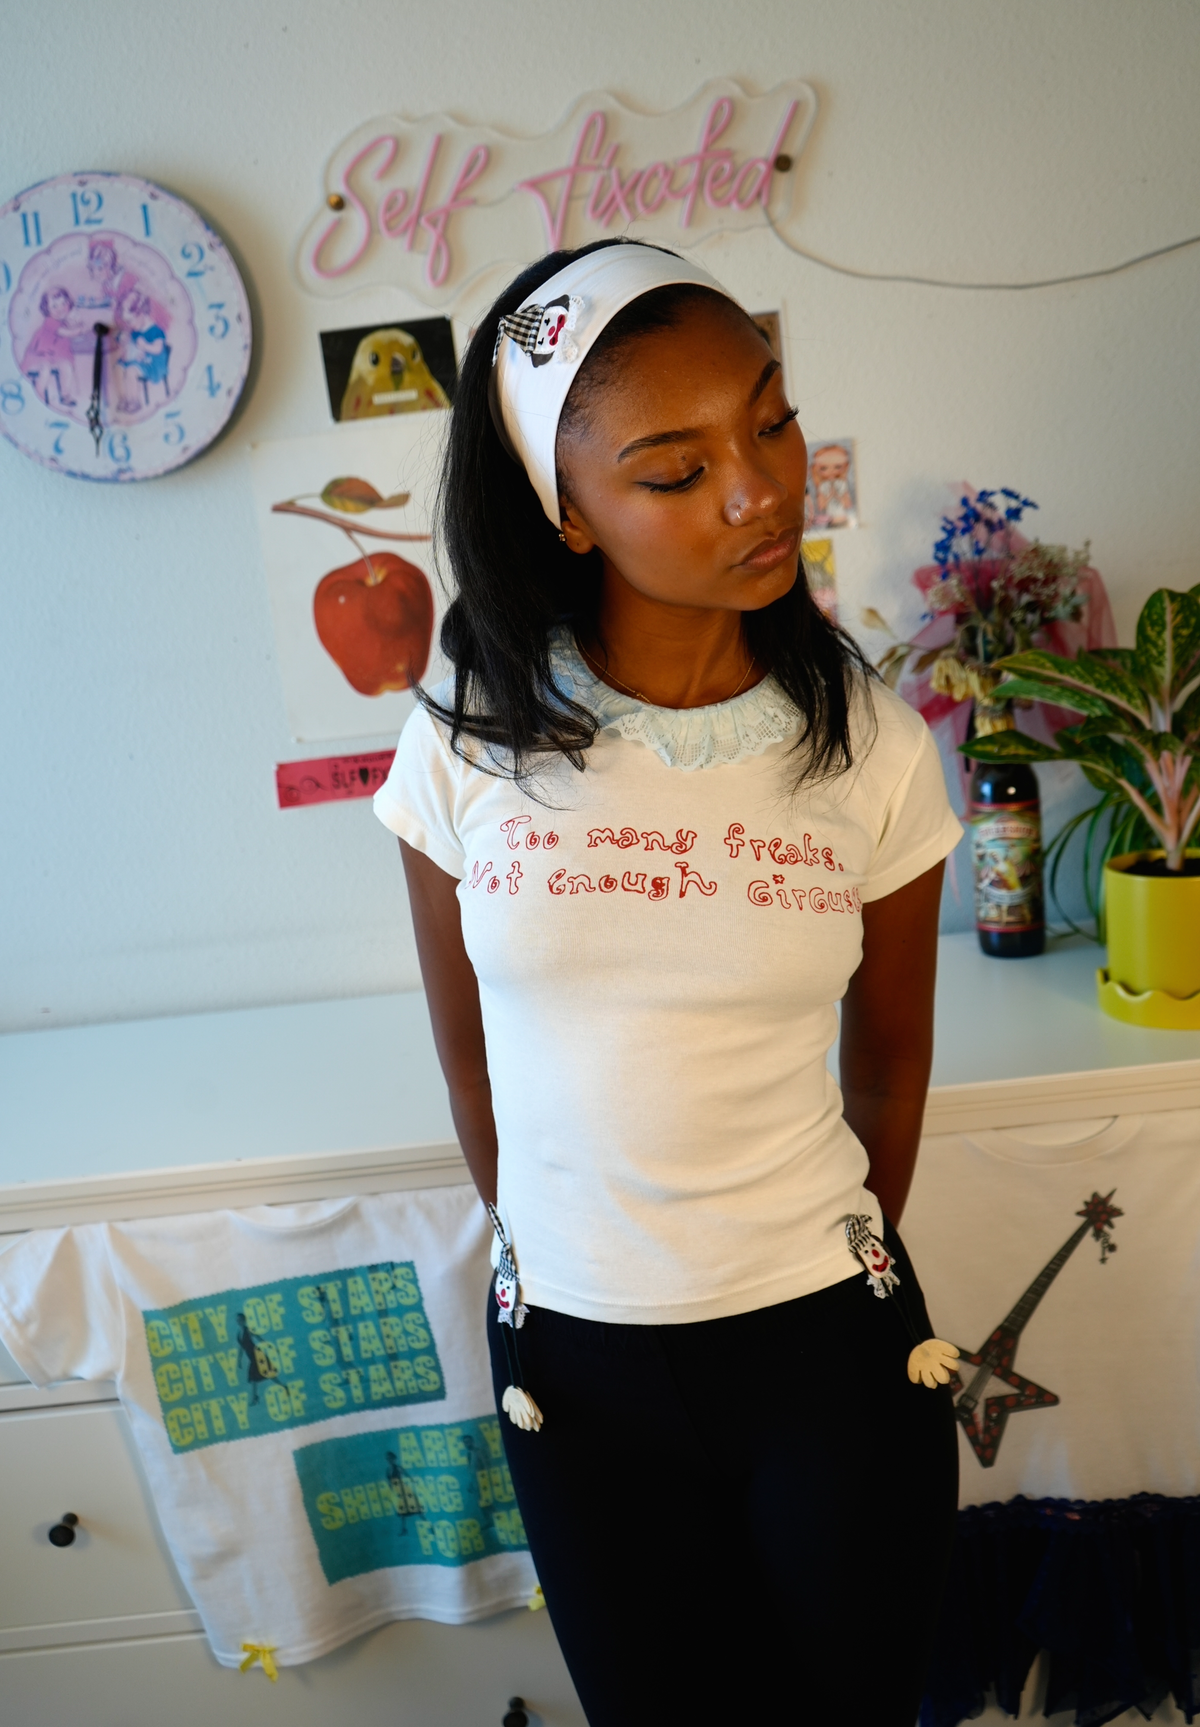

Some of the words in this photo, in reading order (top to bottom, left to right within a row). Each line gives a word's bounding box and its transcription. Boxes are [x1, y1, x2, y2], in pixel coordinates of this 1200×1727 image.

[70, 189, 105, 227] 12
[312, 133, 490, 288] Self
[514, 96, 799, 252] fixated
[21, 210, 42, 247] 11
[140, 202, 151, 237] 1
[181, 242, 205, 278] 2
[207, 302, 229, 339] 3
[0, 379, 25, 416] 8
[199, 364, 221, 398] 4
[49, 421, 69, 454] 7
[163, 410, 185, 446] 5
[107, 432, 131, 464] 6
[500, 815, 559, 850] Too
[587, 827, 697, 854] many
[723, 823, 844, 872] freaks.
[465, 860, 523, 895] Not
[547, 861, 717, 901] enough
[147, 1305, 228, 1357] CITY
[243, 1293, 286, 1335] OF
[297, 1267, 419, 1324] STARS
[155, 1348, 239, 1402] CITY
[254, 1337, 297, 1379] OF
[308, 1312, 430, 1367] STARS
[166, 1392, 249, 1447] CITY
[265, 1379, 307, 1422] OF
[319, 1355, 441, 1409] STARS
[398, 1427, 469, 1468] ARE
[316, 1474, 465, 1530] SHINING
[415, 1518, 485, 1558] FOR
[492, 1507, 528, 1545] M
